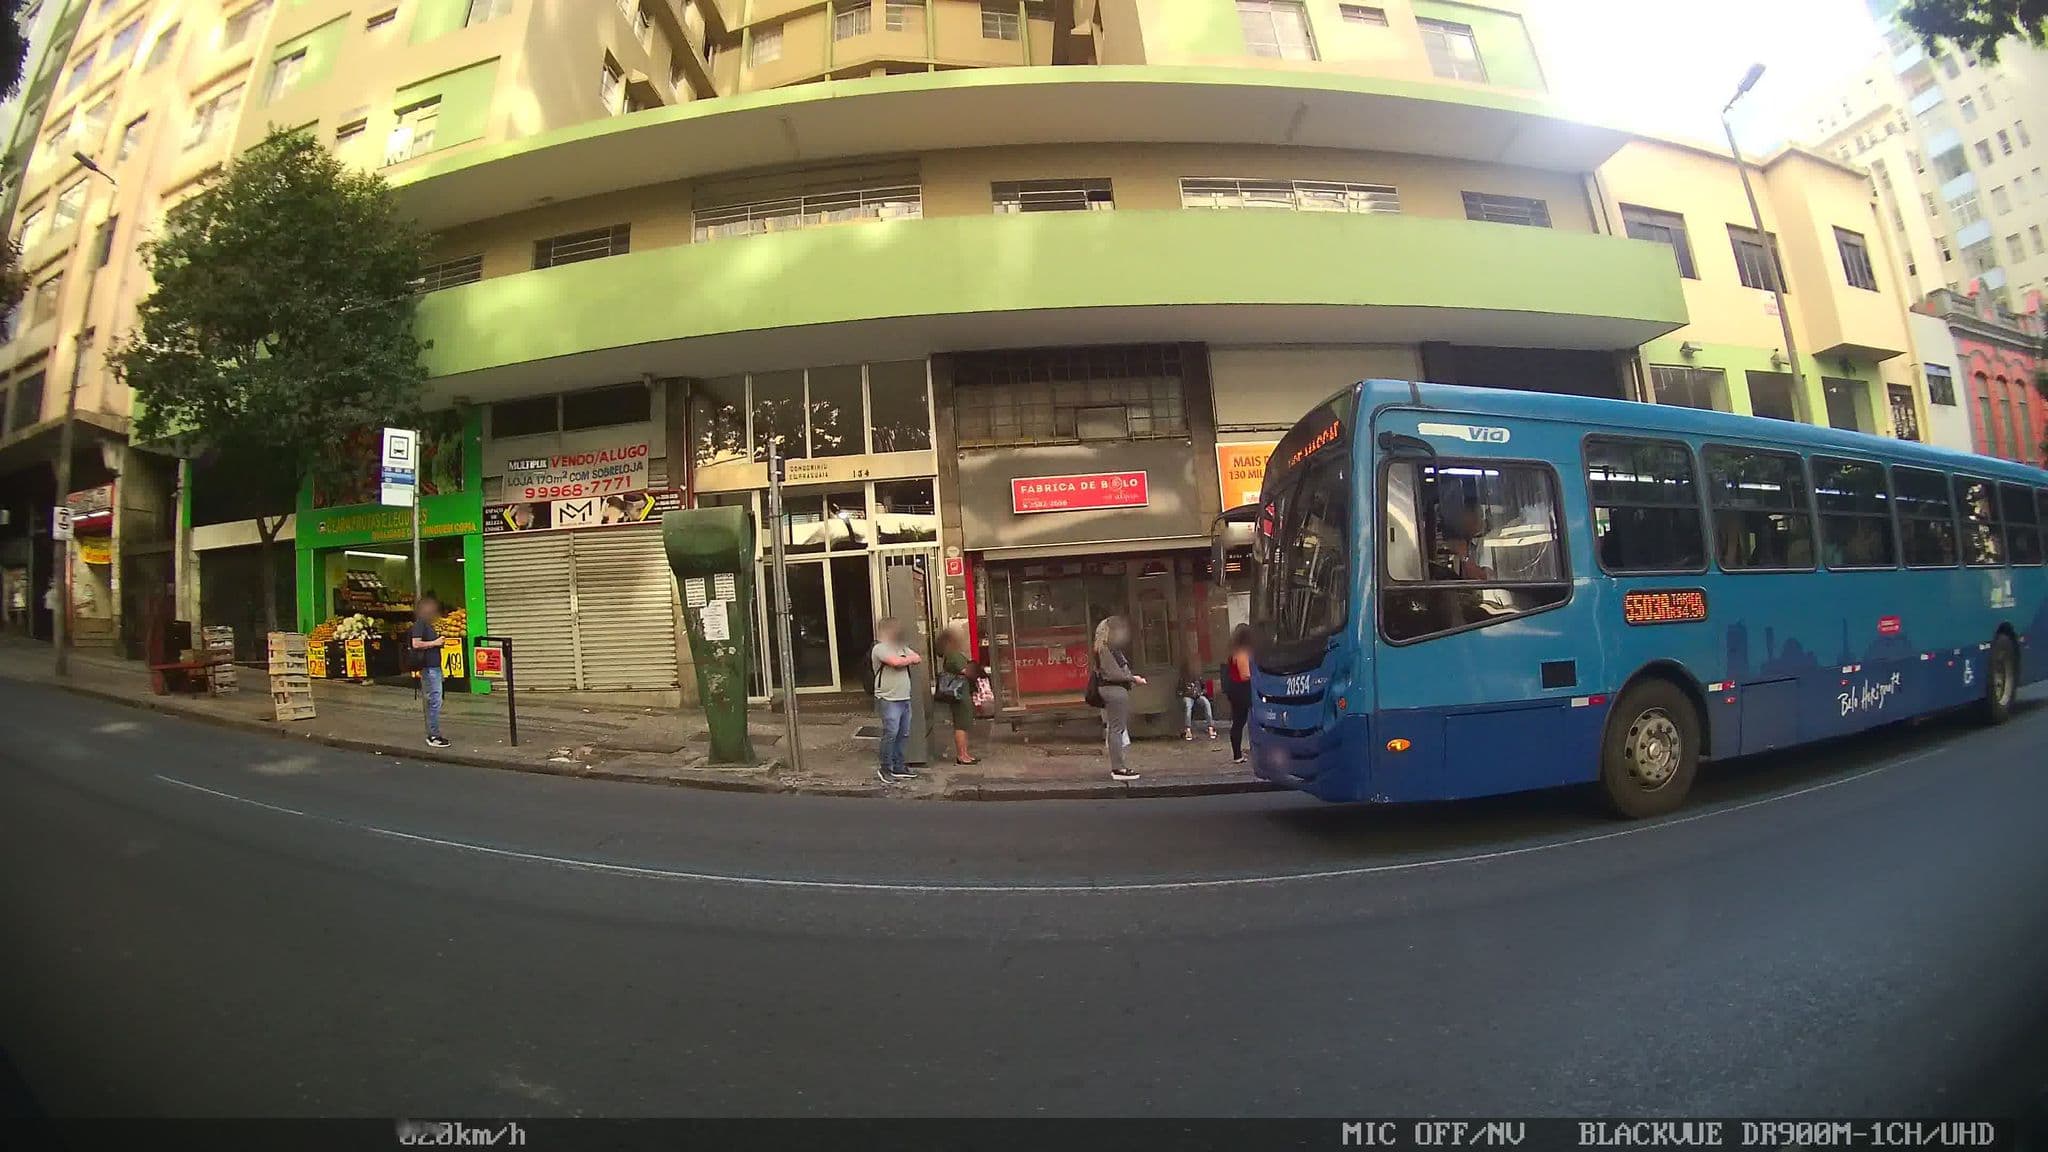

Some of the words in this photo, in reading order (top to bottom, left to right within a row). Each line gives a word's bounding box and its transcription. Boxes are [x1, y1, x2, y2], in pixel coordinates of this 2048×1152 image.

[1468, 427, 1504, 441] Via
[550, 444, 648, 468] VENDO/ALUGO
[1233, 456, 1262, 467] MAIS
[508, 476, 533, 487] LOJA
[570, 471, 589, 483] COM
[592, 462, 643, 479] SOBRELOJA
[1229, 471, 1246, 480] 130
[525, 475, 632, 498] 99968-7771
[1081, 481, 1096, 490] DE
[1671, 593, 1701, 605] TARIFA
[1286, 674, 1311, 696] 20554
[1837, 686, 1858, 716] Belo
[1861, 672, 1900, 712] Horizonte
